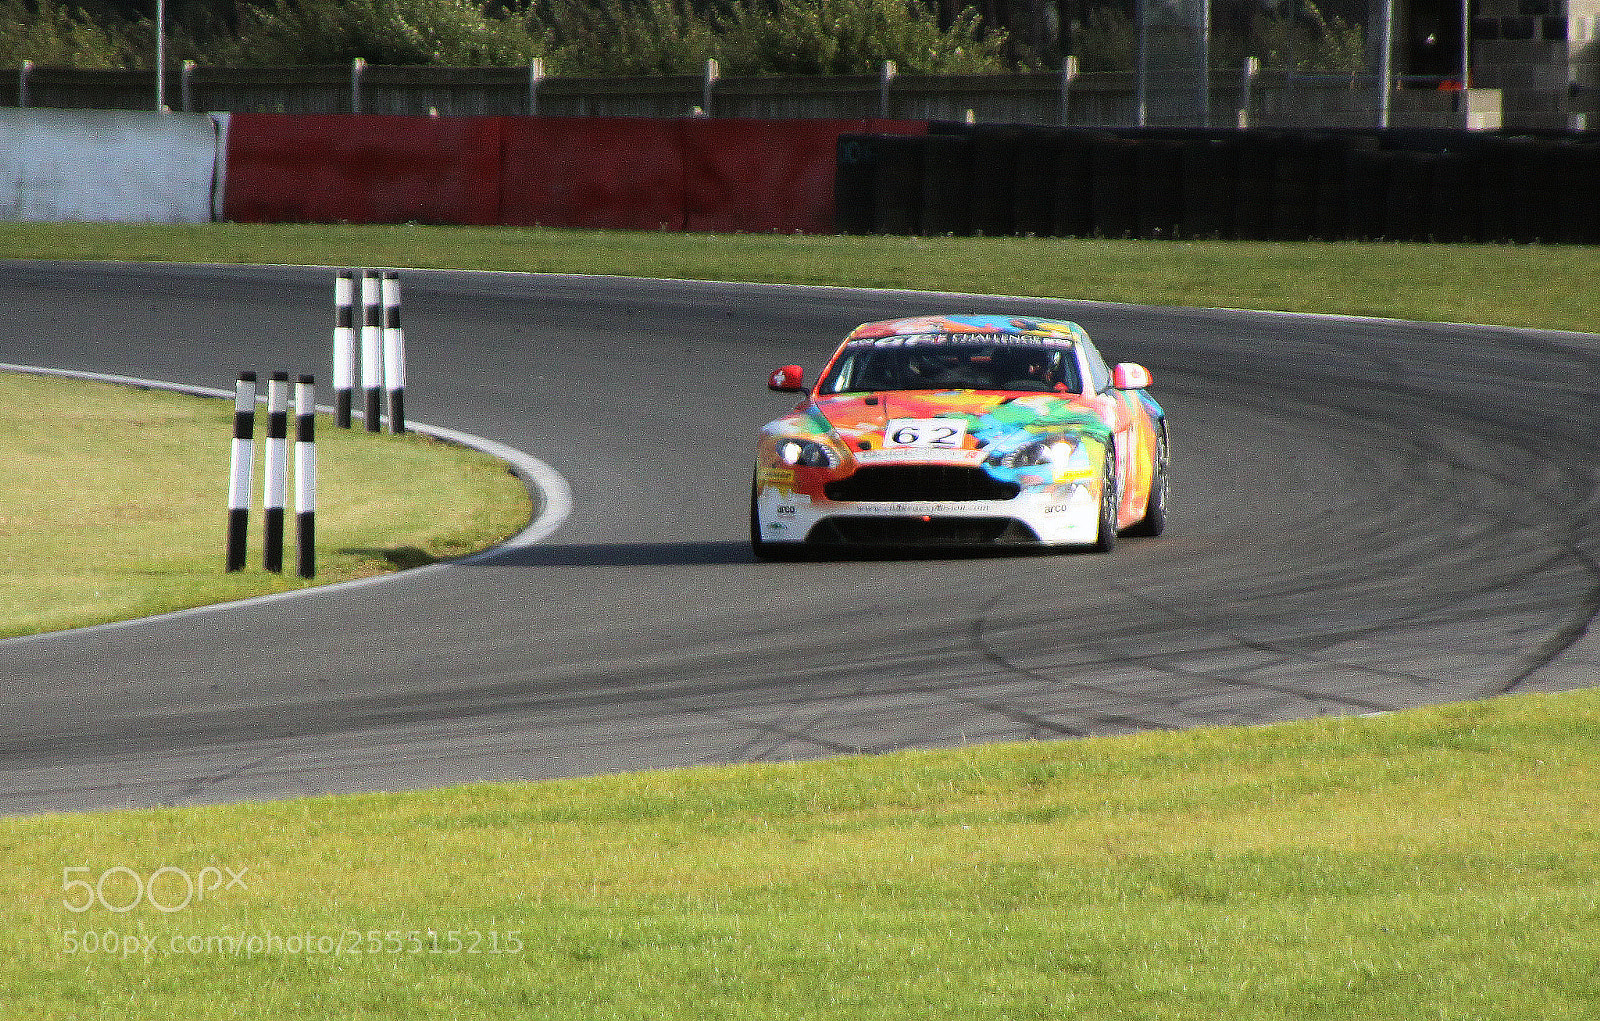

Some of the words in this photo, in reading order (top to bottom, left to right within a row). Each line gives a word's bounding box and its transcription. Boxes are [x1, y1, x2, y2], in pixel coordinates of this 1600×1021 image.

[952, 332, 1042, 345] CHALLENGE
[891, 426, 958, 445] 62
[777, 505, 797, 514] arco
[1044, 503, 1067, 514] arco
